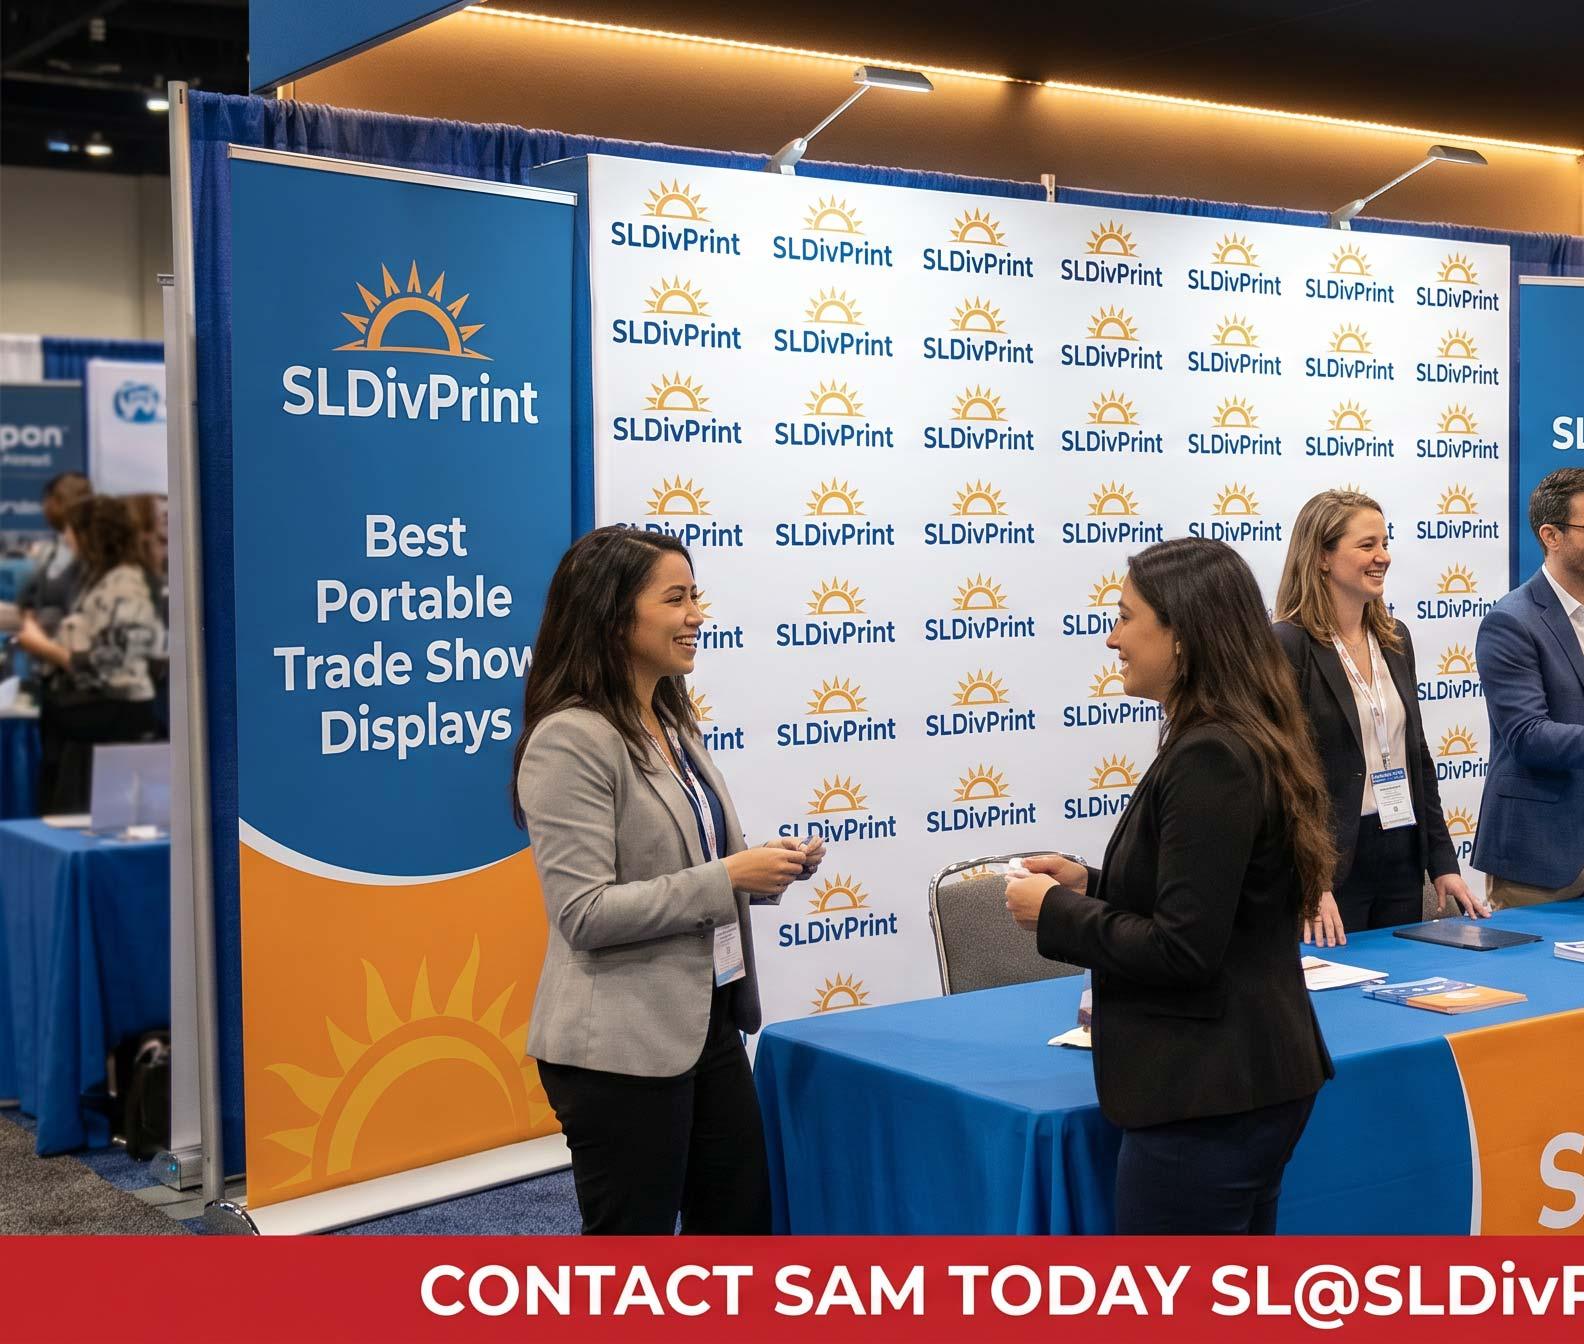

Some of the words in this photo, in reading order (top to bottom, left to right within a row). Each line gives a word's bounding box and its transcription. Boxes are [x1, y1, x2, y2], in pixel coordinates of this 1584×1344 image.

[611, 221, 741, 256] SLDivPrint
[773, 235, 893, 267] SLDivPrint
[923, 248, 1034, 278] SLDivPrint
[1061, 258, 1163, 288] SLDivPrint
[1188, 268, 1281, 296] SLDivPrint
[1305, 278, 1394, 304] SLDivPrint
[1416, 286, 1500, 312] SLDivPrint
[612, 318, 742, 350] SLDivPrint
[774, 328, 893, 358] SLDivPrint
[923, 336, 1034, 364] SLDivPrint
[1061, 344, 1163, 371] SLDivPrint
[1188, 350, 1281, 376] SLDivPrint
[1305, 357, 1394, 381] SLDivPrint
[1416, 362, 1499, 385] SLDivPrint
[282, 365, 540, 425] SLDivPrint
[613, 416, 743, 444] SLDivPrint
[775, 421, 894, 448] SLDivPrint
[924, 425, 1035, 451] SLDivPrint
[1061, 429, 1164, 454] SLDivPrint
[1188, 433, 1281, 456] SLDivPrint
[1305, 435, 1393, 458] SLDivPrint
[1416, 438, 1499, 459] SLDivPrint
[366, 514, 468, 557] Best
[616, 521, 744, 547] ivPrint
[775, 521, 895, 547] SLDivPrint
[924, 522, 1035, 545] SLDivPrint
[1062, 520, 1164, 544] SLDivPrint
[1188, 520, 1283, 542] SLDivPrint
[1416, 520, 1499, 540] SLDivPrint
[317, 575, 512, 623] Portable
[776, 619, 896, 647] SLDivPrint
[925, 614, 1035, 641] SLDivPrint
[1062, 611, 1119, 636] SLDiv
[273, 640, 412, 691] Trade
[426, 637, 534, 684] Show
[1417, 679, 1484, 701] SLDivPri
[925, 709, 1036, 737] SLDivPrint
[1062, 699, 1165, 728] SLDivPrint
[321, 701, 512, 760] Displays
[777, 716, 896, 747] SLDivPrint
[926, 802, 1037, 833] SLDivPrint
[1063, 792, 1131, 820] SLDivP
[778, 912, 897, 948] SLDivPrint
